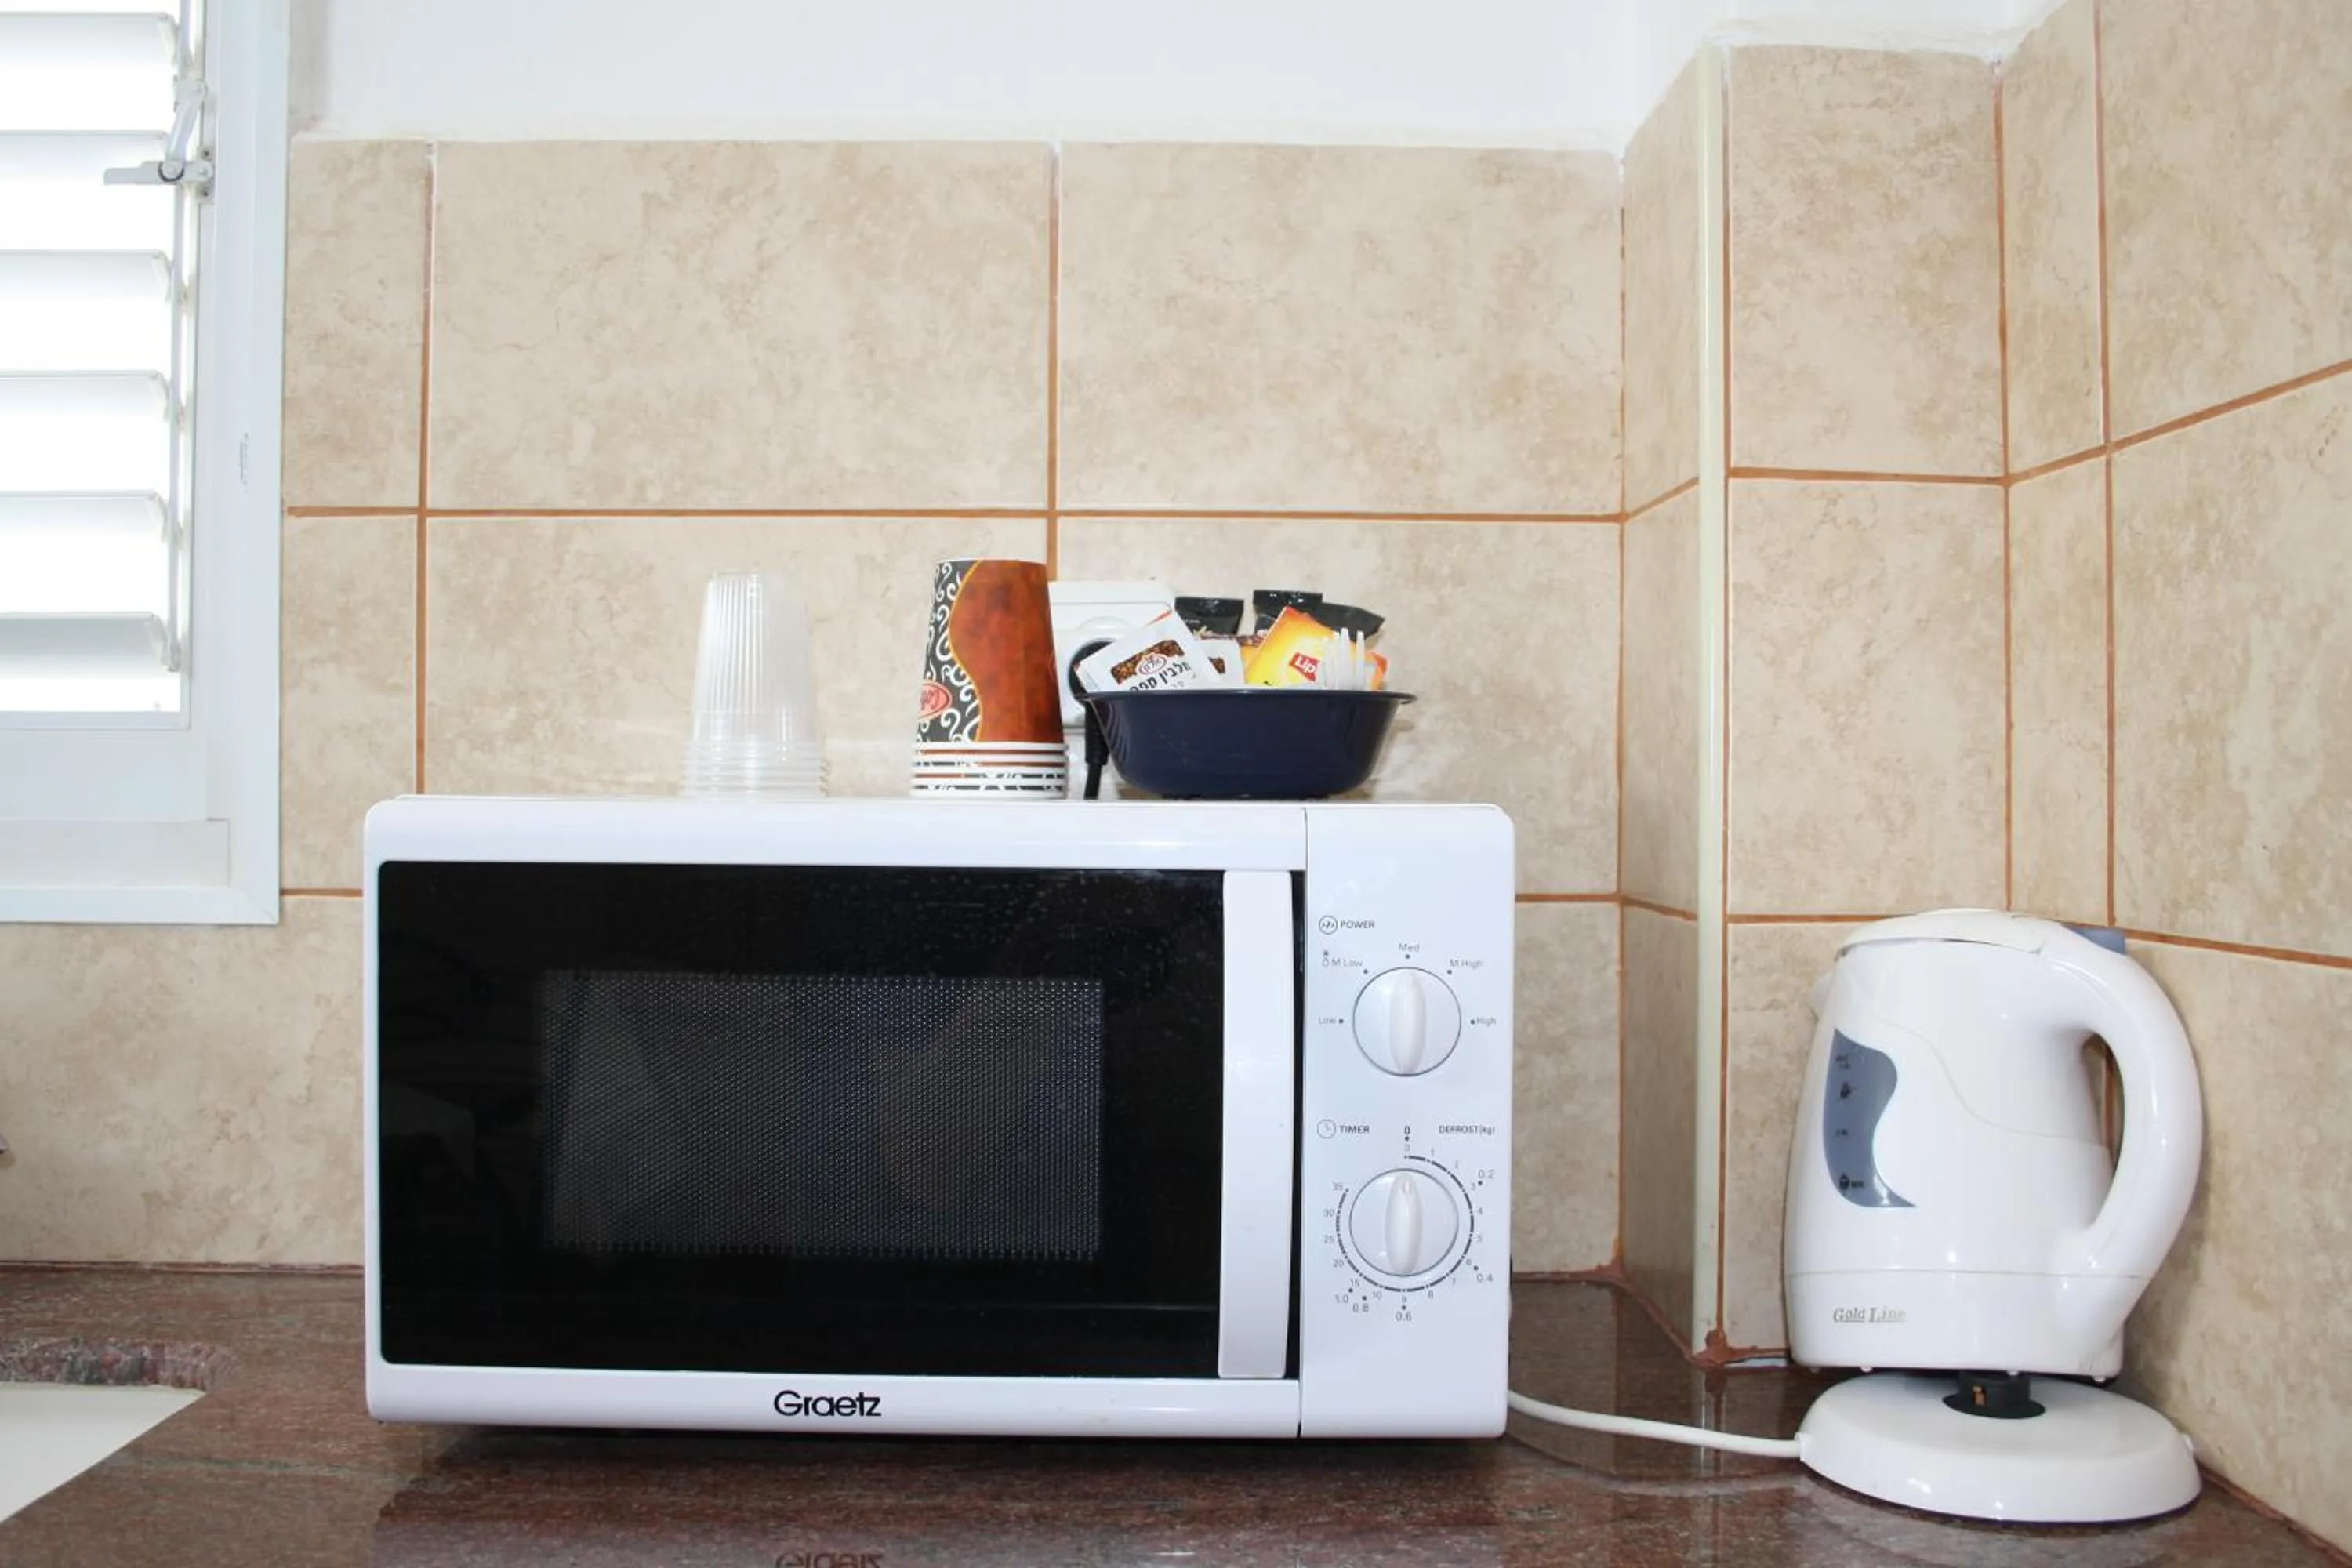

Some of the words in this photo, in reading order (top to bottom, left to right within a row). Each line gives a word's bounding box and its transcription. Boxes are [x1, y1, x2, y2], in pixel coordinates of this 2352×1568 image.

[1339, 920, 1375, 929] POWER
[1398, 942, 1420, 953] Med
[1318, 1015, 1338, 1025] Low
[1476, 1017, 1497, 1027] High
[1339, 1124, 1370, 1134] TIMER
[1404, 1125, 1410, 1134] 0
[1477, 1169, 1494, 1179] 02
[1323, 1235, 1334, 1244] 25
[1333, 1259, 1345, 1269] 20
[1349, 1278, 1360, 1287] 15
[1476, 1273, 1494, 1283] 04
[1372, 1291, 1383, 1301] 10
[1352, 1303, 1370, 1313] 08
[1395, 1310, 1413, 1322] 0.6
[1832, 1307, 1866, 1323] Gold
[1867, 1305, 1907, 1323] Line
[773, 1389, 882, 1417] Graetz
